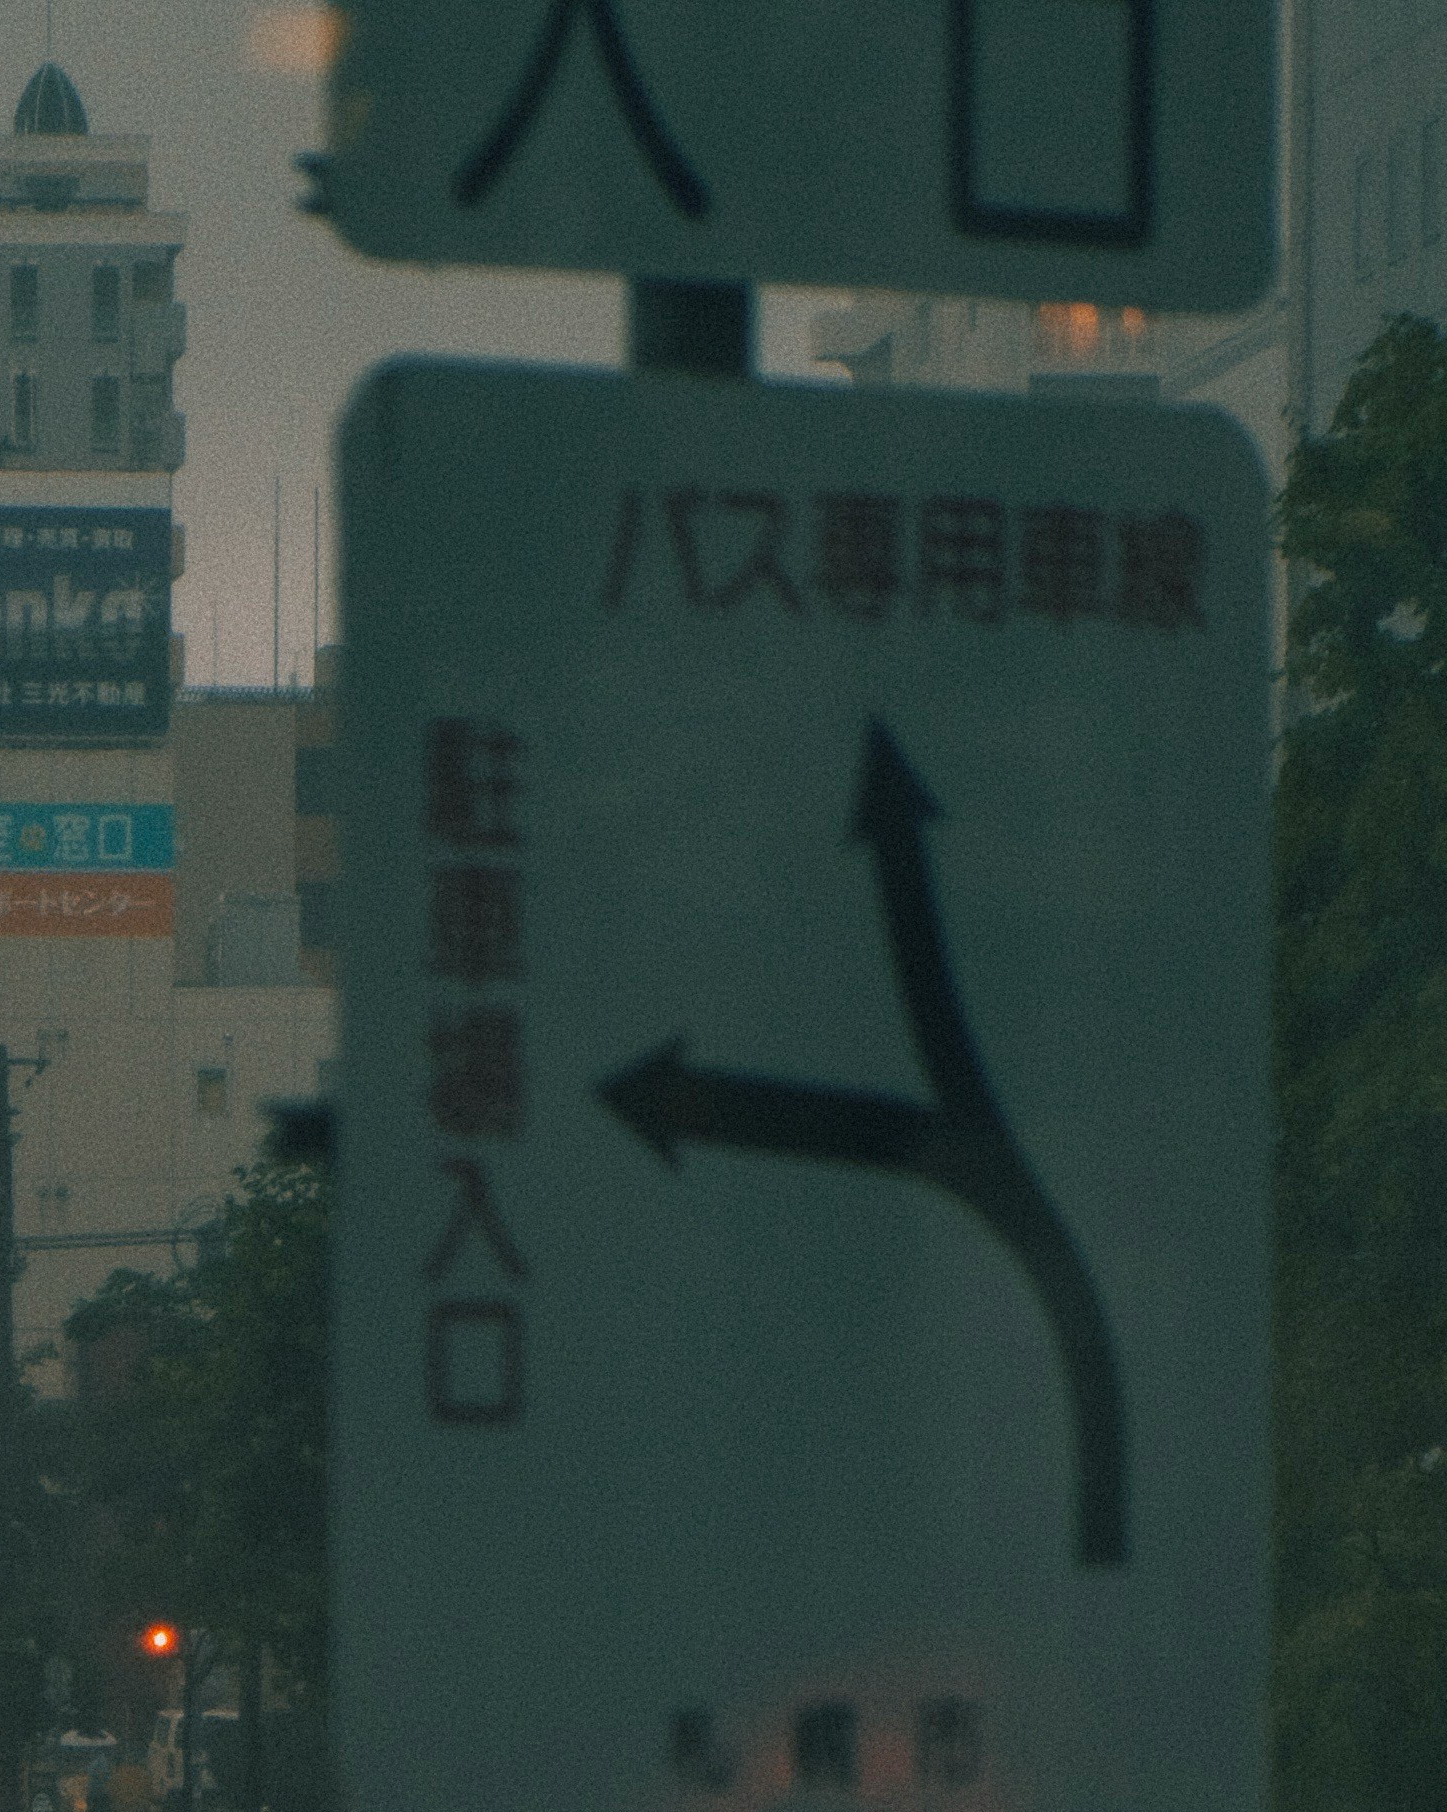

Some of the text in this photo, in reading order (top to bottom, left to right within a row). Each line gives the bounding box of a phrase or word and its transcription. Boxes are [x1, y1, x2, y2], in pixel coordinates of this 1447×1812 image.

[601, 484, 1211, 634] バス専用車線
[21, 681, 147, 707] 三光不動産
